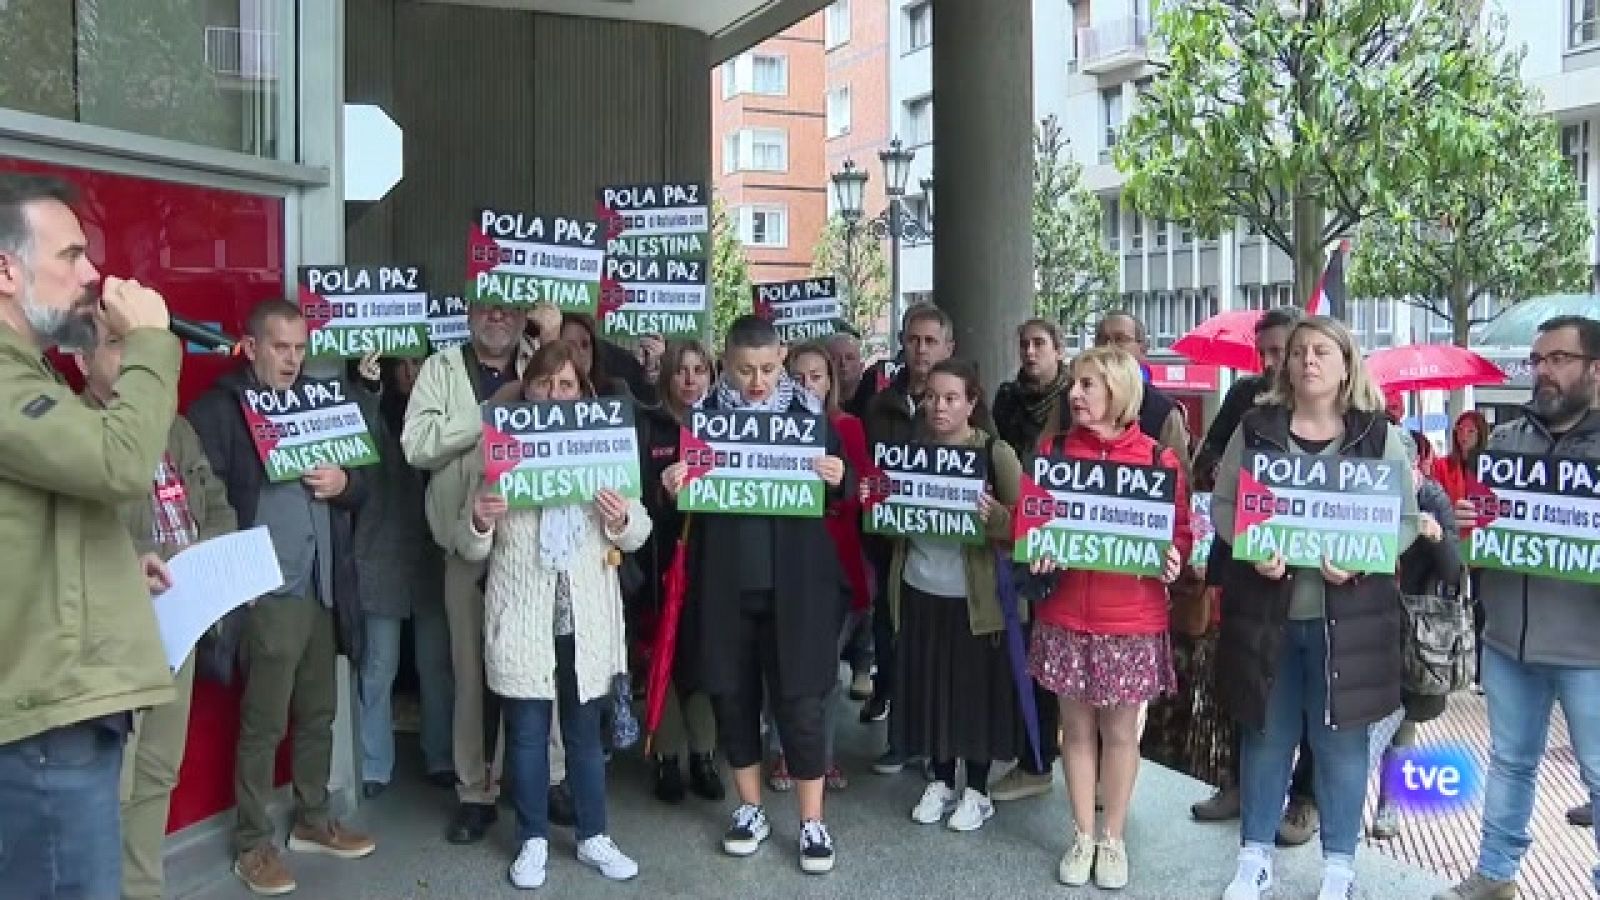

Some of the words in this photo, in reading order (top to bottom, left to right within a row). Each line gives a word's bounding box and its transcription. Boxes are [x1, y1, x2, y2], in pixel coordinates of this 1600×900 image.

[604, 187, 656, 208] POLA
[663, 184, 698, 206] PAZ
[482, 210, 544, 239] POLA
[555, 217, 597, 246] PAZ
[607, 235, 702, 257] PALESTINA
[308, 266, 371, 293] POLA
[379, 266, 418, 291] PAZ
[607, 259, 658, 281] POLA
[667, 261, 698, 281] PAZ
[477, 271, 591, 306] PALESTINA
[758, 284, 801, 303] POLA
[804, 279, 832, 298] PAZ
[604, 311, 698, 335] PALESTINA
[311, 327, 420, 356] PALESTINA
[245, 389, 300, 412] POLA
[303, 380, 345, 408] PAZ
[494, 404, 566, 433] POLA
[575, 402, 623, 428] PAZ
[692, 412, 759, 441] POLA
[769, 416, 816, 443] PAZ
[269, 435, 370, 476] PALESTINA
[557, 439, 610, 455] d'Asturies
[612, 437, 632, 452] con
[875, 442, 928, 469] POLA
[936, 447, 976, 474] PAZ
[500, 465, 632, 501] PALESTINA
[1034, 457, 1105, 491] POLA
[1117, 465, 1166, 498] PAZ
[1254, 453, 1326, 486] POLA
[1339, 460, 1391, 491] PAZ
[1477, 454, 1546, 487] POLA
[689, 479, 815, 509] PALESTINA
[872, 502, 976, 536] PALESTINA
[1090, 504, 1145, 526] d'Asturies
[1147, 513, 1168, 529] con
[1311, 501, 1369, 522] d'Asturies
[1371, 506, 1393, 523] con
[1532, 504, 1589, 528] d'Asturies
[1027, 527, 1162, 568] PALESTINA
[1247, 525, 1388, 563] PALESTINA
